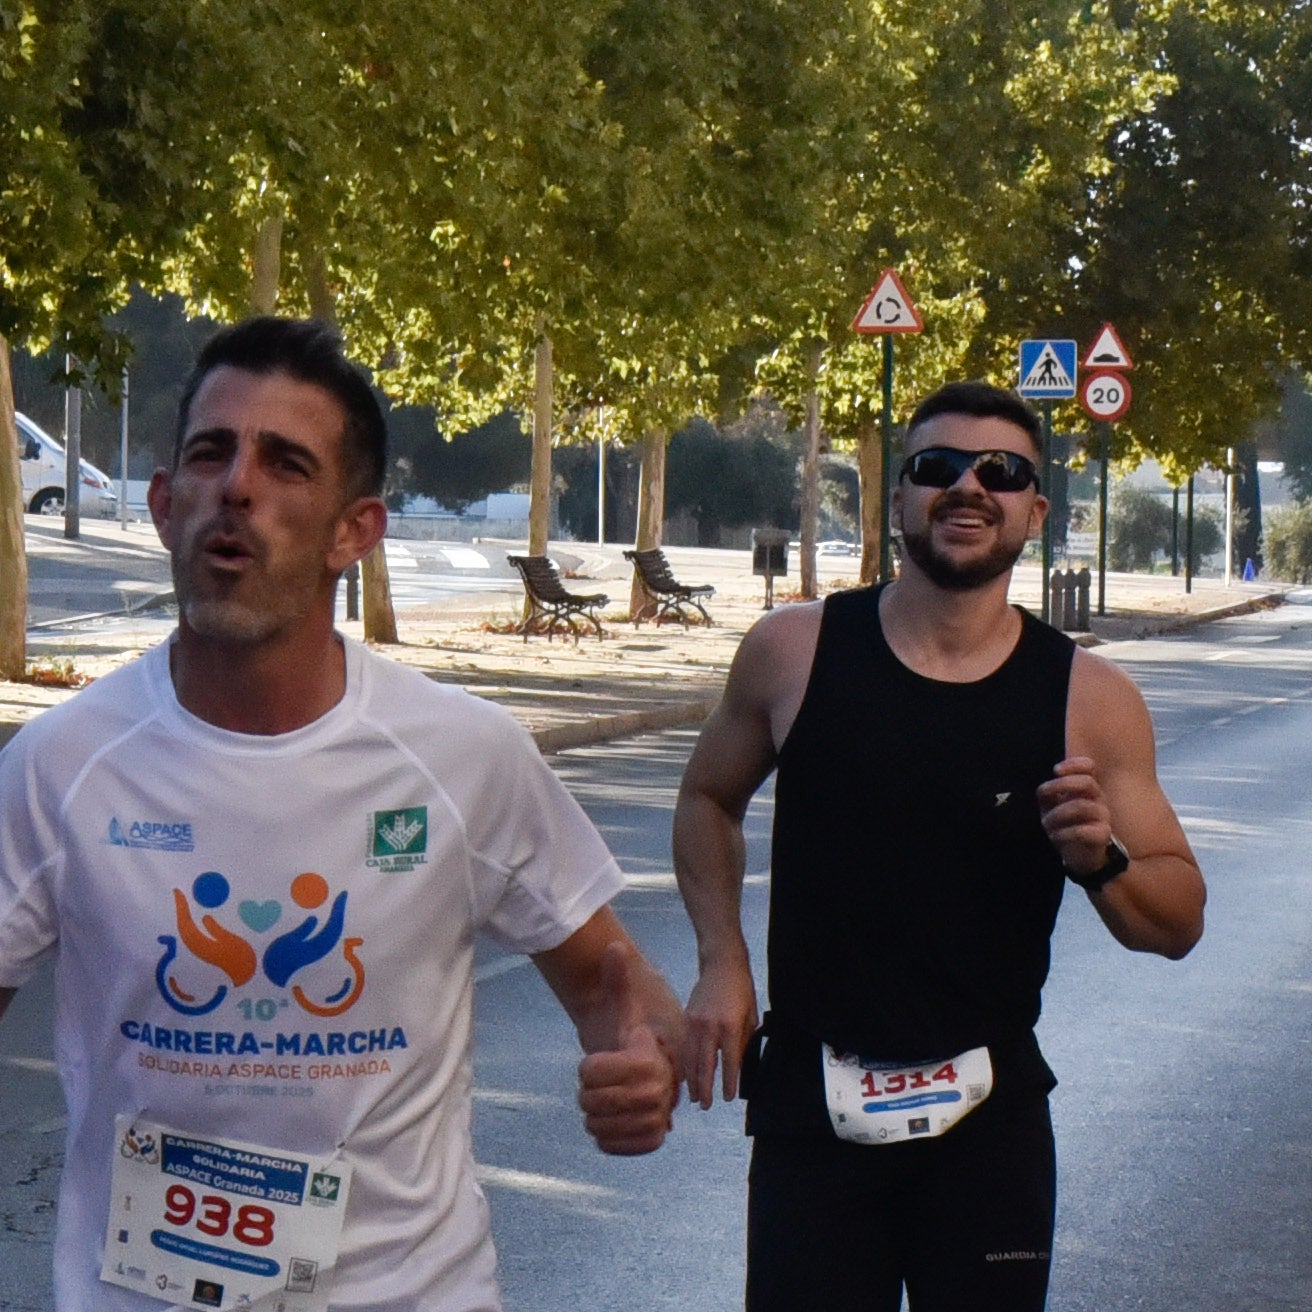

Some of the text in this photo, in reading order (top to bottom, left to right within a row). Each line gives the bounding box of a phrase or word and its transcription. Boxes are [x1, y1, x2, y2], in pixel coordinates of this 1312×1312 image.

[1093, 388, 1120, 404] 20
[129, 821, 192, 839] ASPACE
[119, 1019, 408, 1057] CARRERA-MARCHA
[138, 1052, 392, 1080] SOLIDARIA ASPACE GRANADA
[860, 1062, 959, 1098] 1314
[165, 1137, 303, 1174] CARRERA-MARCHA
[192, 1154, 266, 1181] SOLIDARIA
[165, 1162, 212, 1184] ASPACE
[213, 1175, 265, 1197] Granada
[268, 1188, 299, 1203] 2025
[163, 1184, 276, 1247] 938
[985, 1251, 1037, 1262] GUARDIA
